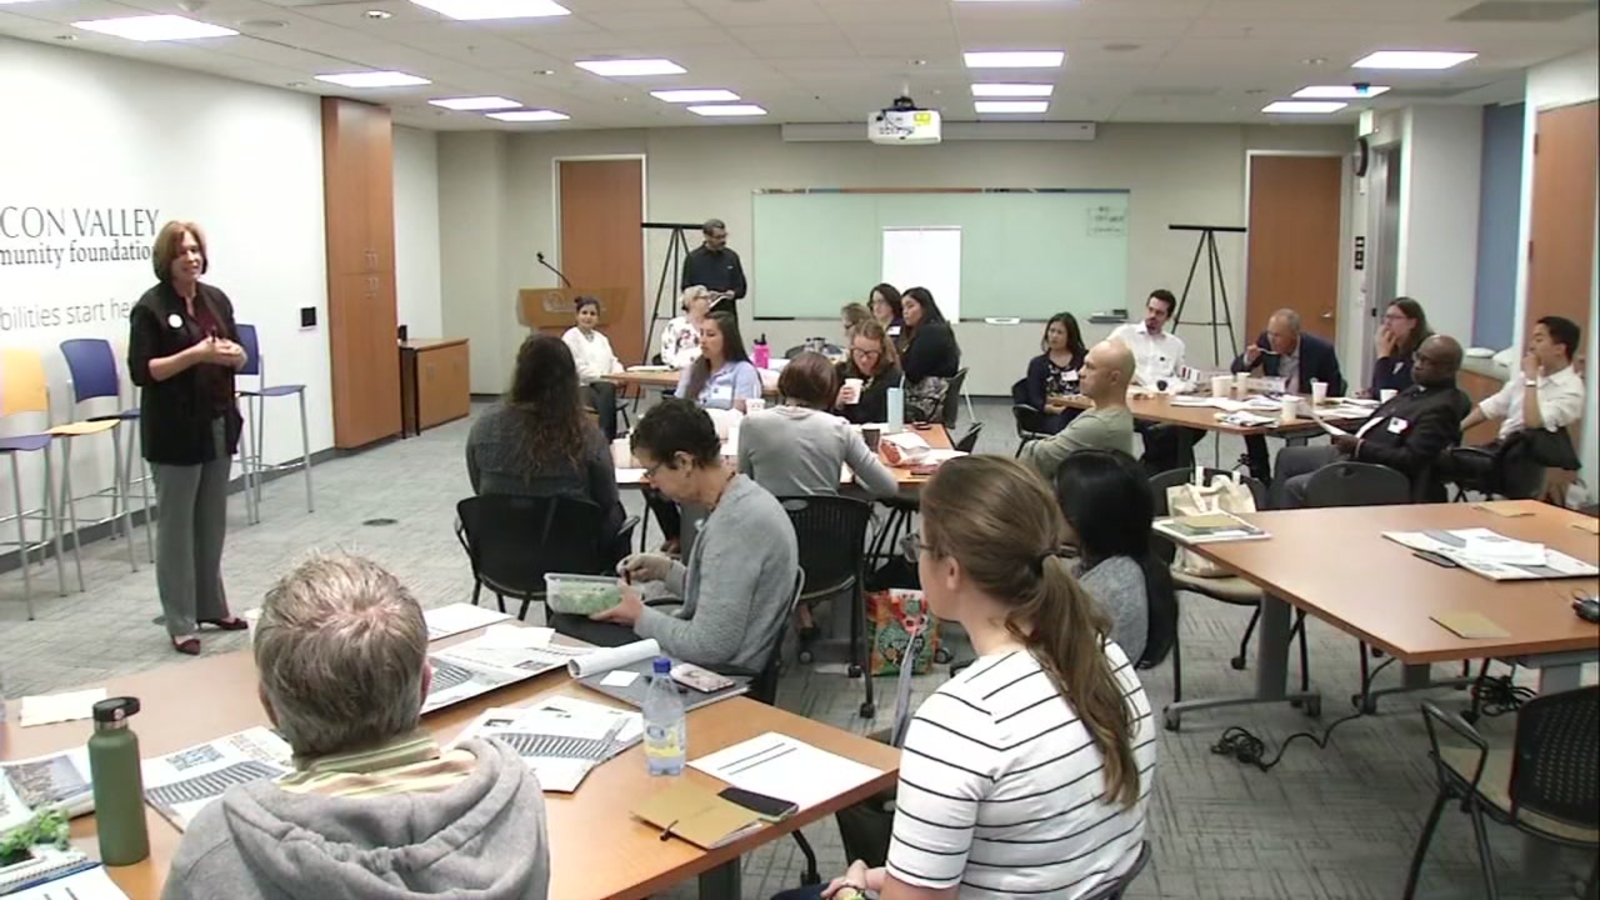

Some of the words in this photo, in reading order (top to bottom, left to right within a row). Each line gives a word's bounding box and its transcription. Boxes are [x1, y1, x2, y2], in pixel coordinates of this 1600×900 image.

[0, 206, 65, 239] CON
[73, 208, 160, 237] VALLEY
[70, 239, 154, 263] foundatio
[66, 302, 106, 325] start
